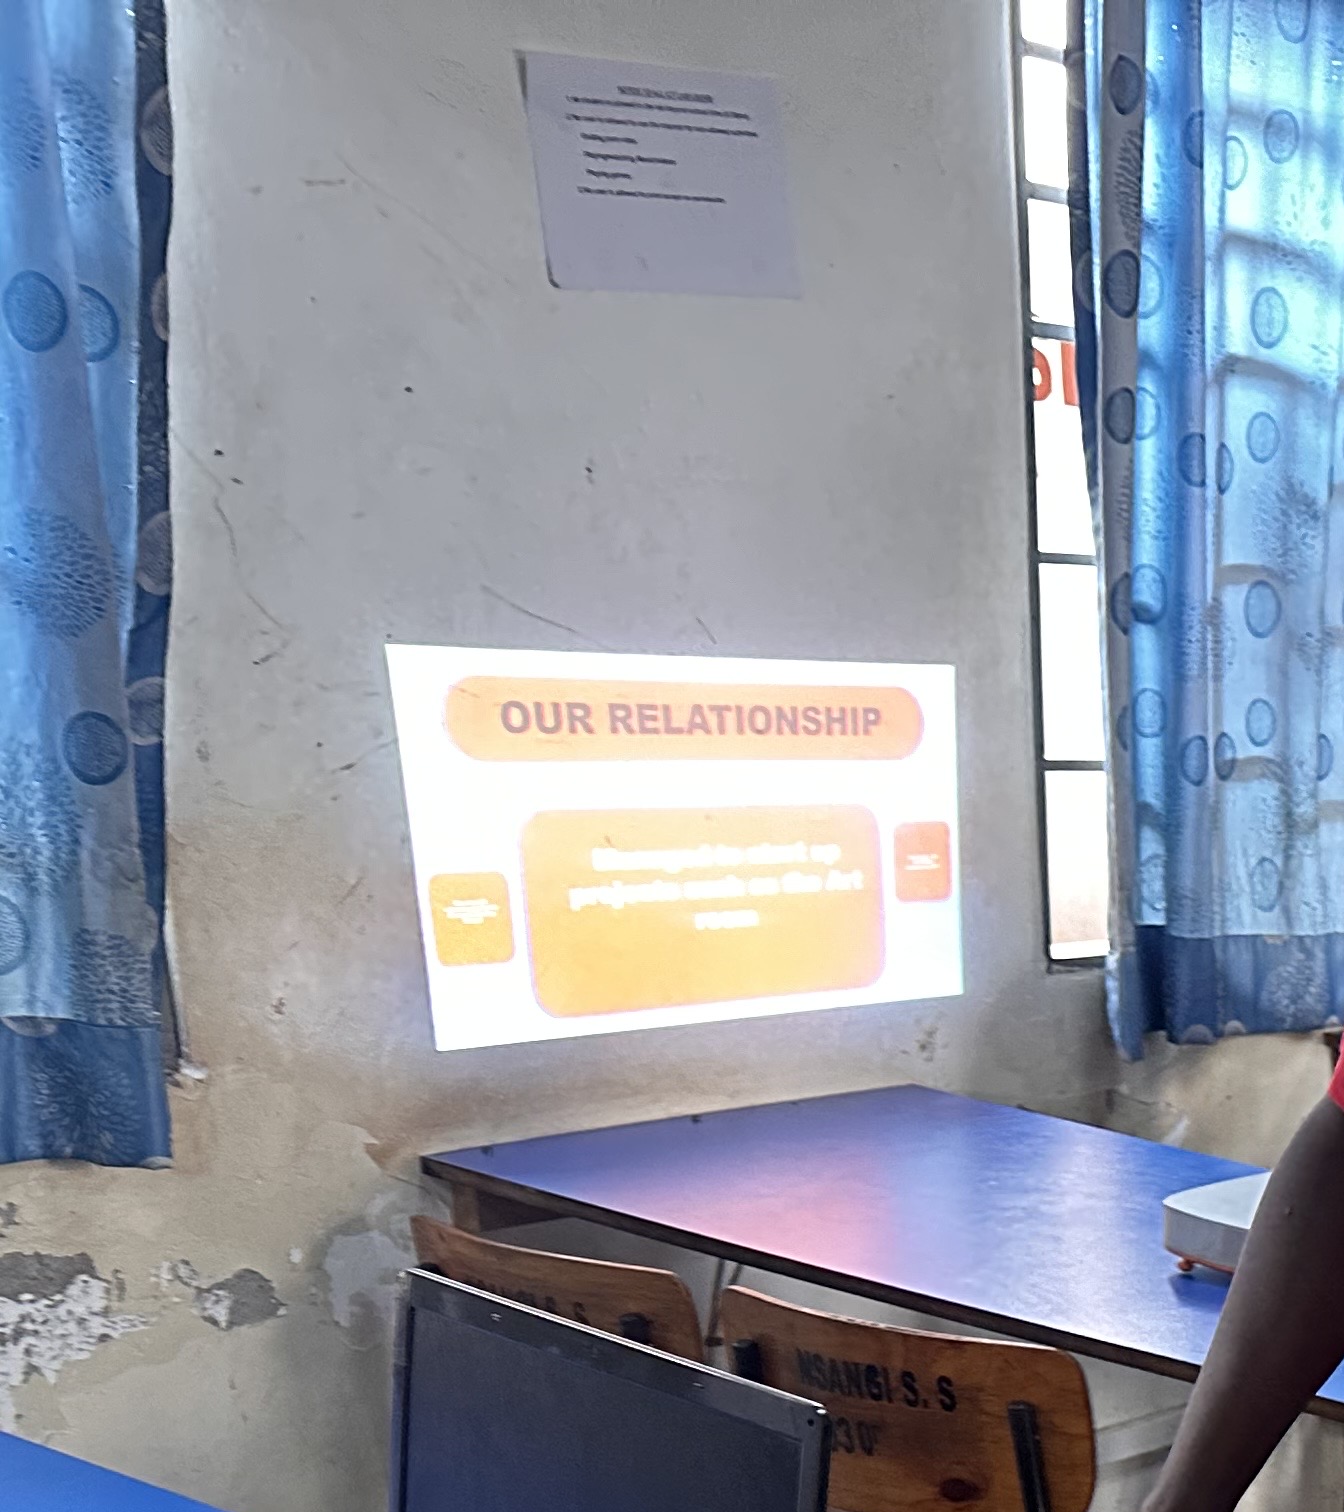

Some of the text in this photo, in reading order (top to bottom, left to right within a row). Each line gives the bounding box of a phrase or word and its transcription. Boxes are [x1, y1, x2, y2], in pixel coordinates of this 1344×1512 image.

[500, 699, 883, 738] OUR RELATIONSHIP
[936, 1375, 958, 1412] S
